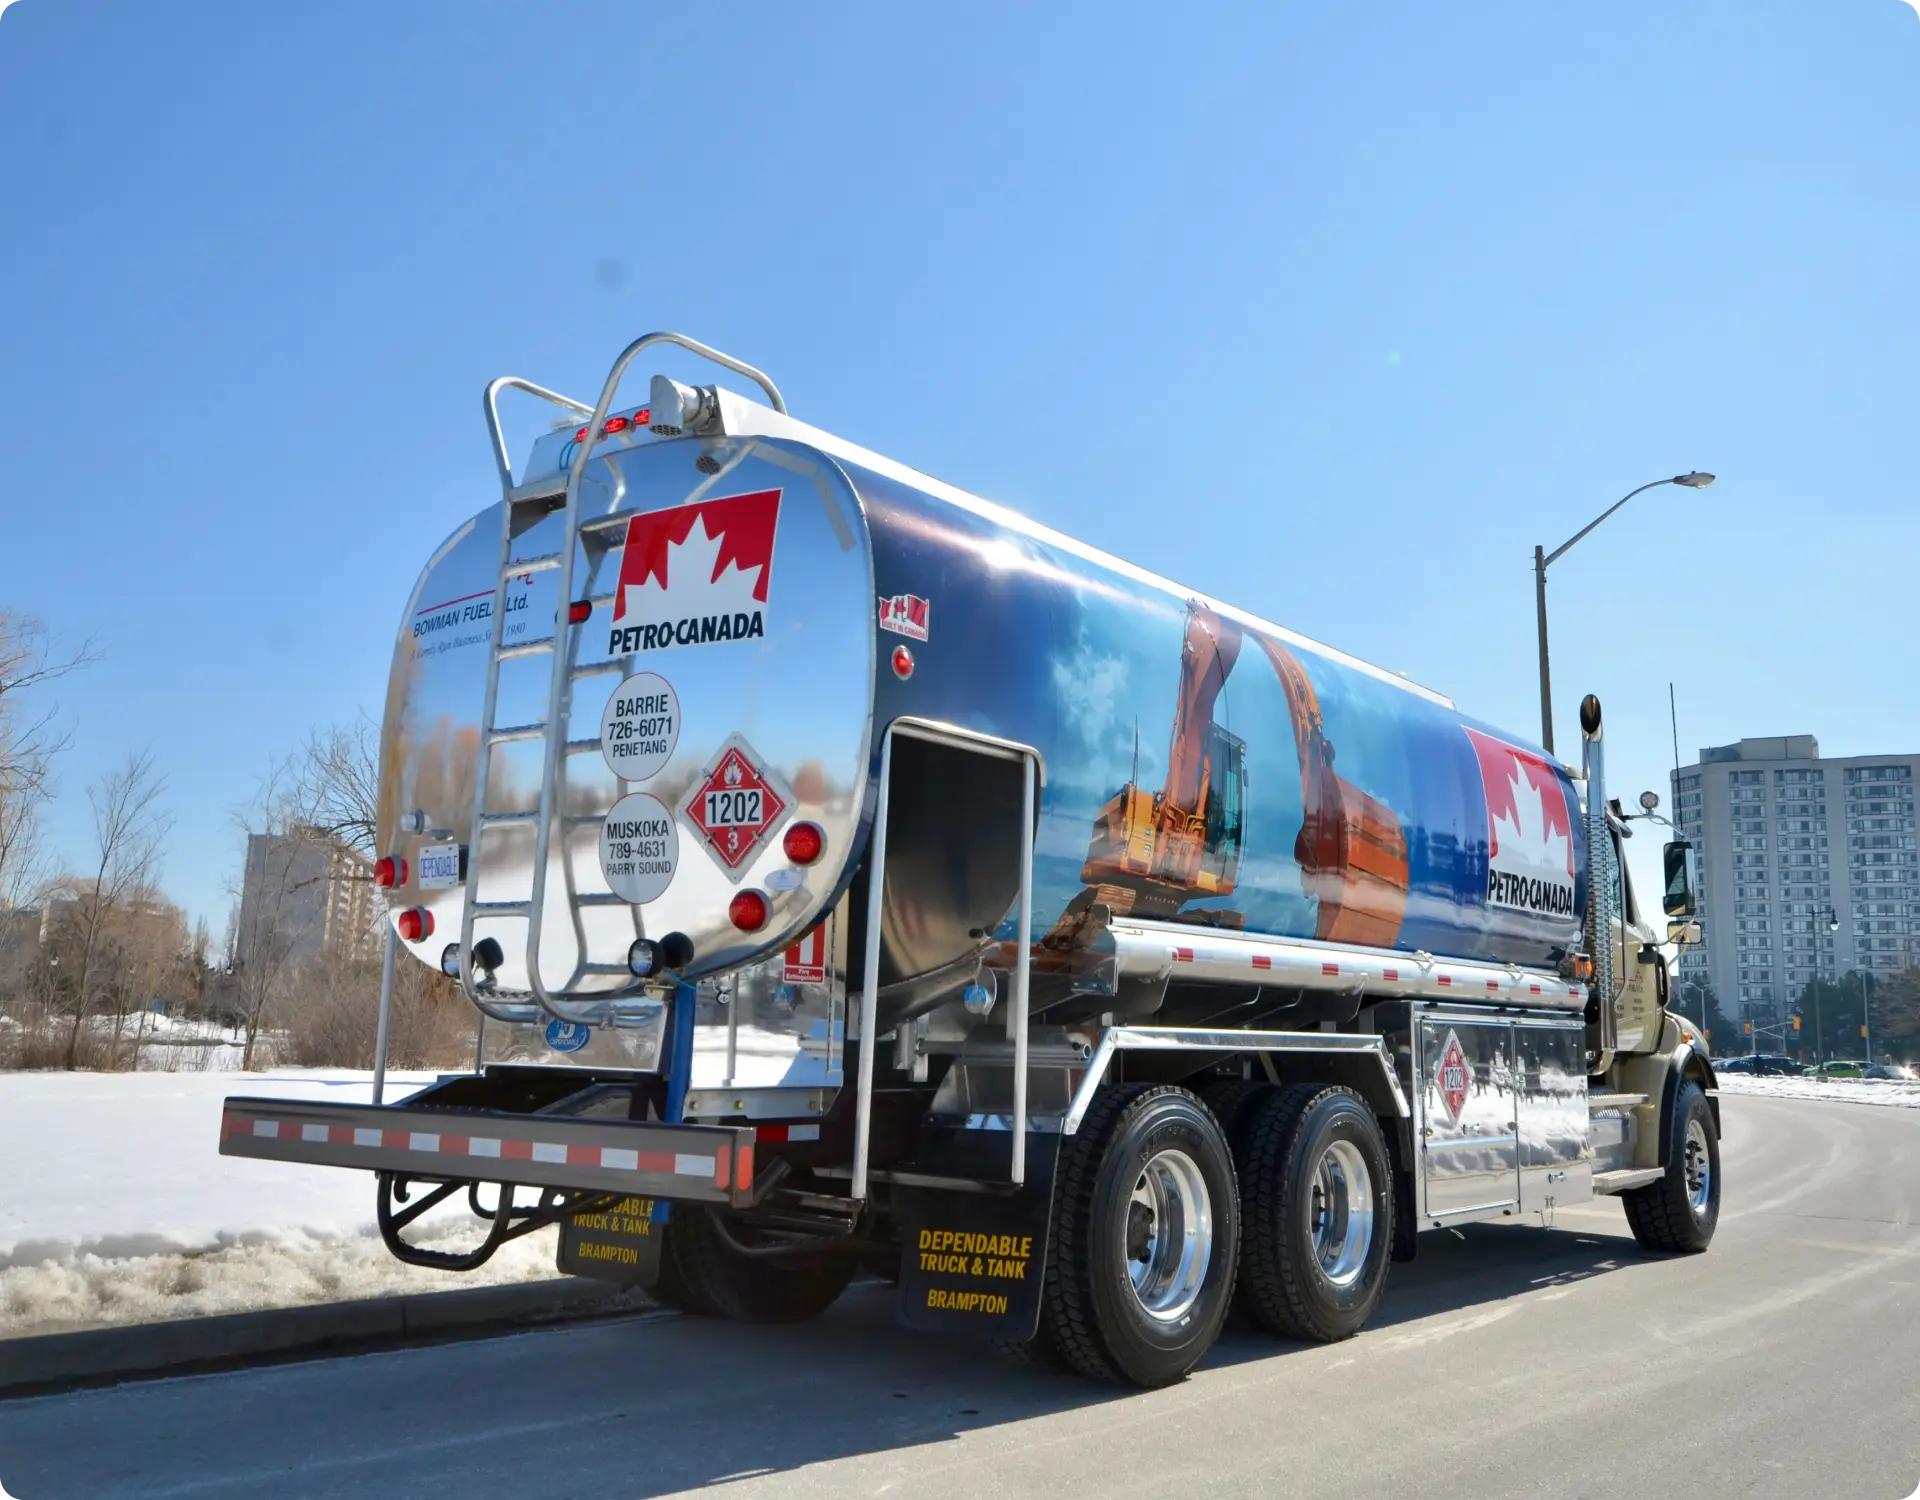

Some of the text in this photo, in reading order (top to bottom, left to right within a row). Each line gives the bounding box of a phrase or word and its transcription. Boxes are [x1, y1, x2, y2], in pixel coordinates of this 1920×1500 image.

[412, 610, 461, 638] BOWMAN
[463, 602, 494, 624] FUEL
[505, 593, 529, 613] Ltd.
[608, 610, 764, 656] PETRO-CANADA
[616, 693, 669, 718] BARRIE
[608, 716, 672, 741] 726-6071
[612, 739, 667, 758] PENETANG
[708, 791, 760, 824] 1202
[606, 819, 670, 840] MUSKOKA
[608, 840, 667, 859] 789-4631
[727, 831, 739, 854] 3
[420, 855, 458, 878] DEPENDABLE
[606, 860, 672, 877] PARRY SOUND
[1487, 868, 1573, 917] PETRO-CANADA
[1445, 1068, 1463, 1089] 1202
[574, 1212, 651, 1236] TRUCK & TANK
[578, 1241, 639, 1265] BRAMPTON
[919, 1229, 1032, 1258] DEPENDABLE
[920, 1252, 1026, 1279] TRUCK & TANK
[927, 1288, 1008, 1315] BRAMPTON
